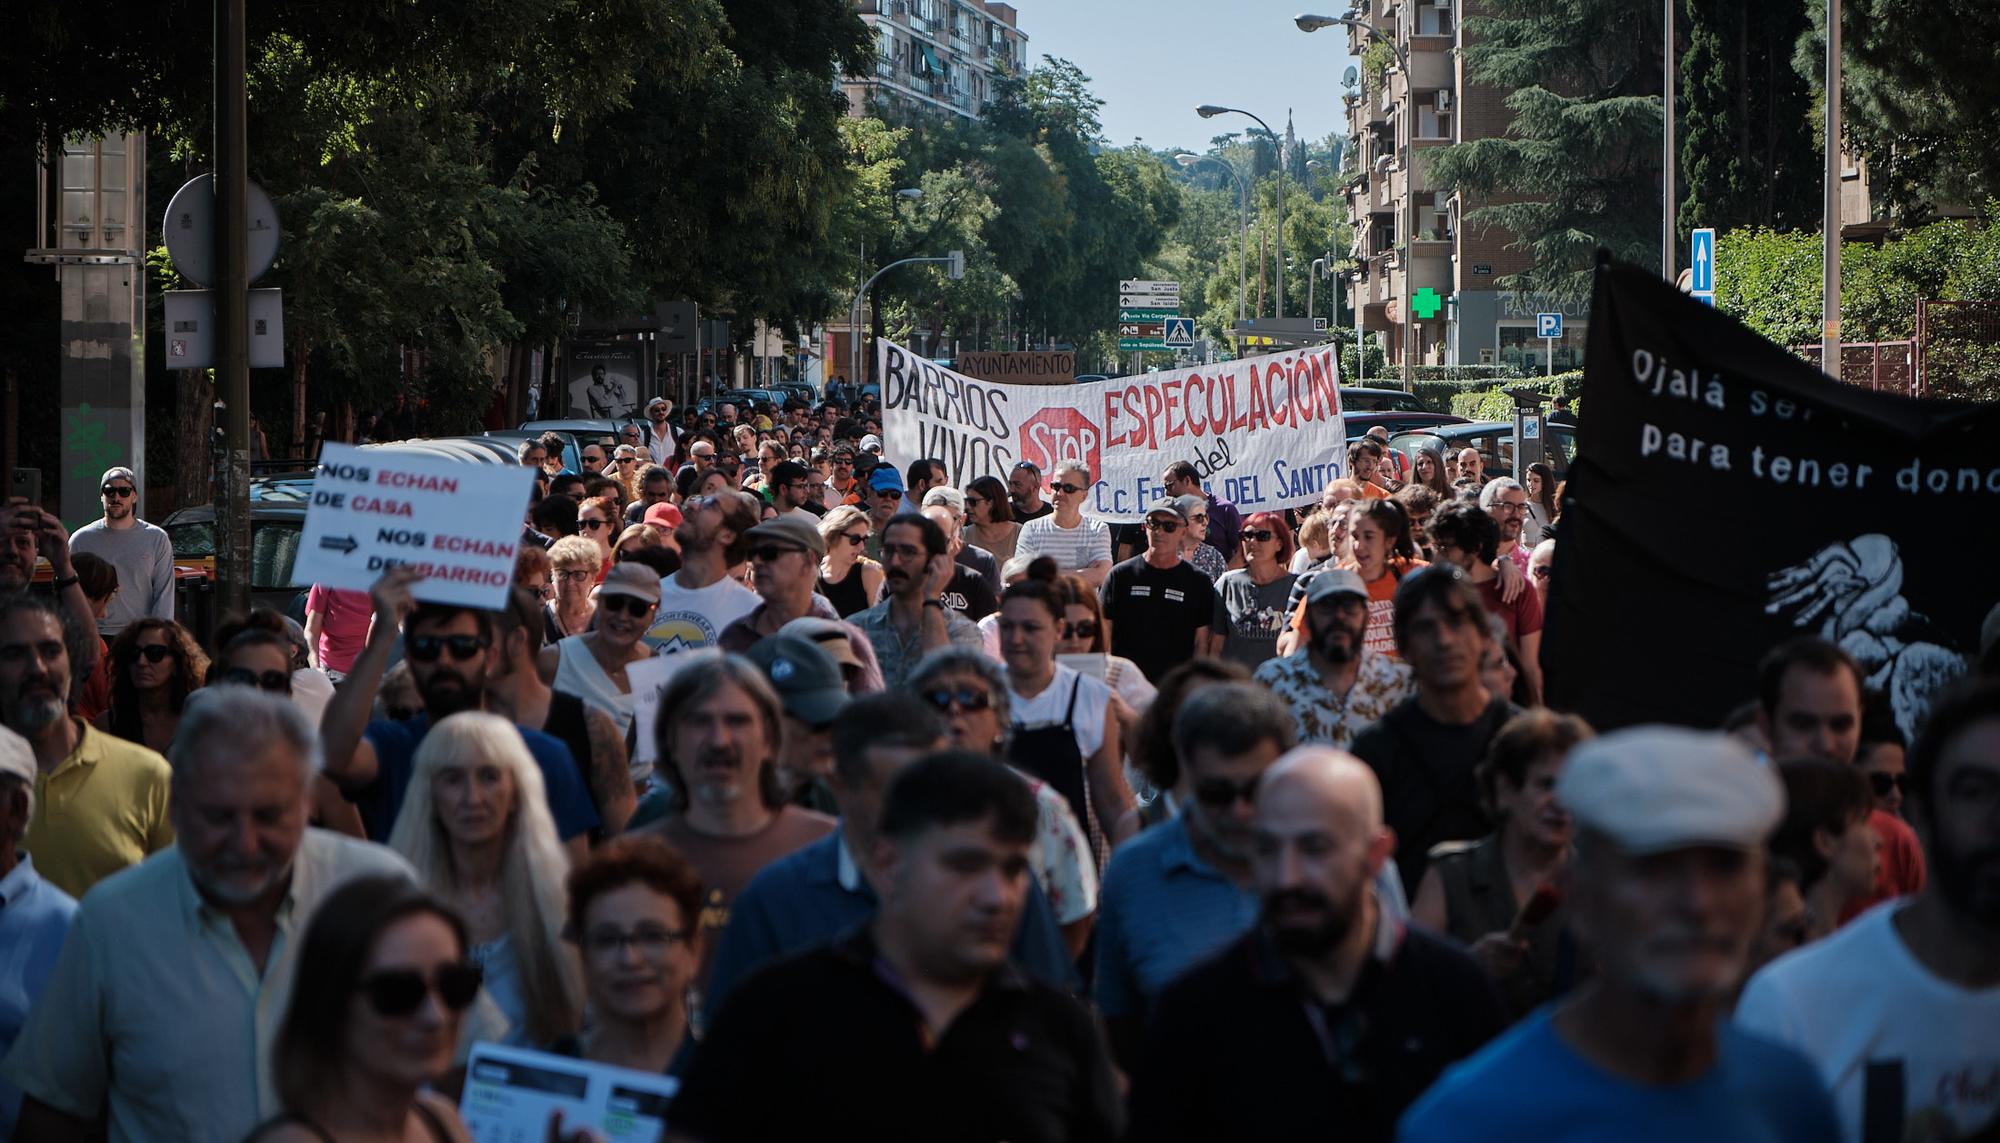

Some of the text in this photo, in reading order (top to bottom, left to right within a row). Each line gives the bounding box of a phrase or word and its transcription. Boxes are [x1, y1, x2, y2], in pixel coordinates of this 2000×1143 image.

[1541, 316, 1556, 335] P
[885, 346, 1010, 440] BARRIOS
[1633, 349, 1725, 410] Ojalá
[919, 420, 1011, 497] VIVOS
[1029, 422, 1095, 476] STOP
[1194, 437, 1237, 479] del
[1641, 423, 1731, 470] para
[1752, 446, 1872, 488] tener
[320, 463, 459, 494] NOS ECHAN
[1225, 475, 1266, 506] DEL
[314, 490, 413, 519] DE CASA
[376, 527, 515, 559] NOS ECHAN
[415, 562, 507, 587] BARRIO
